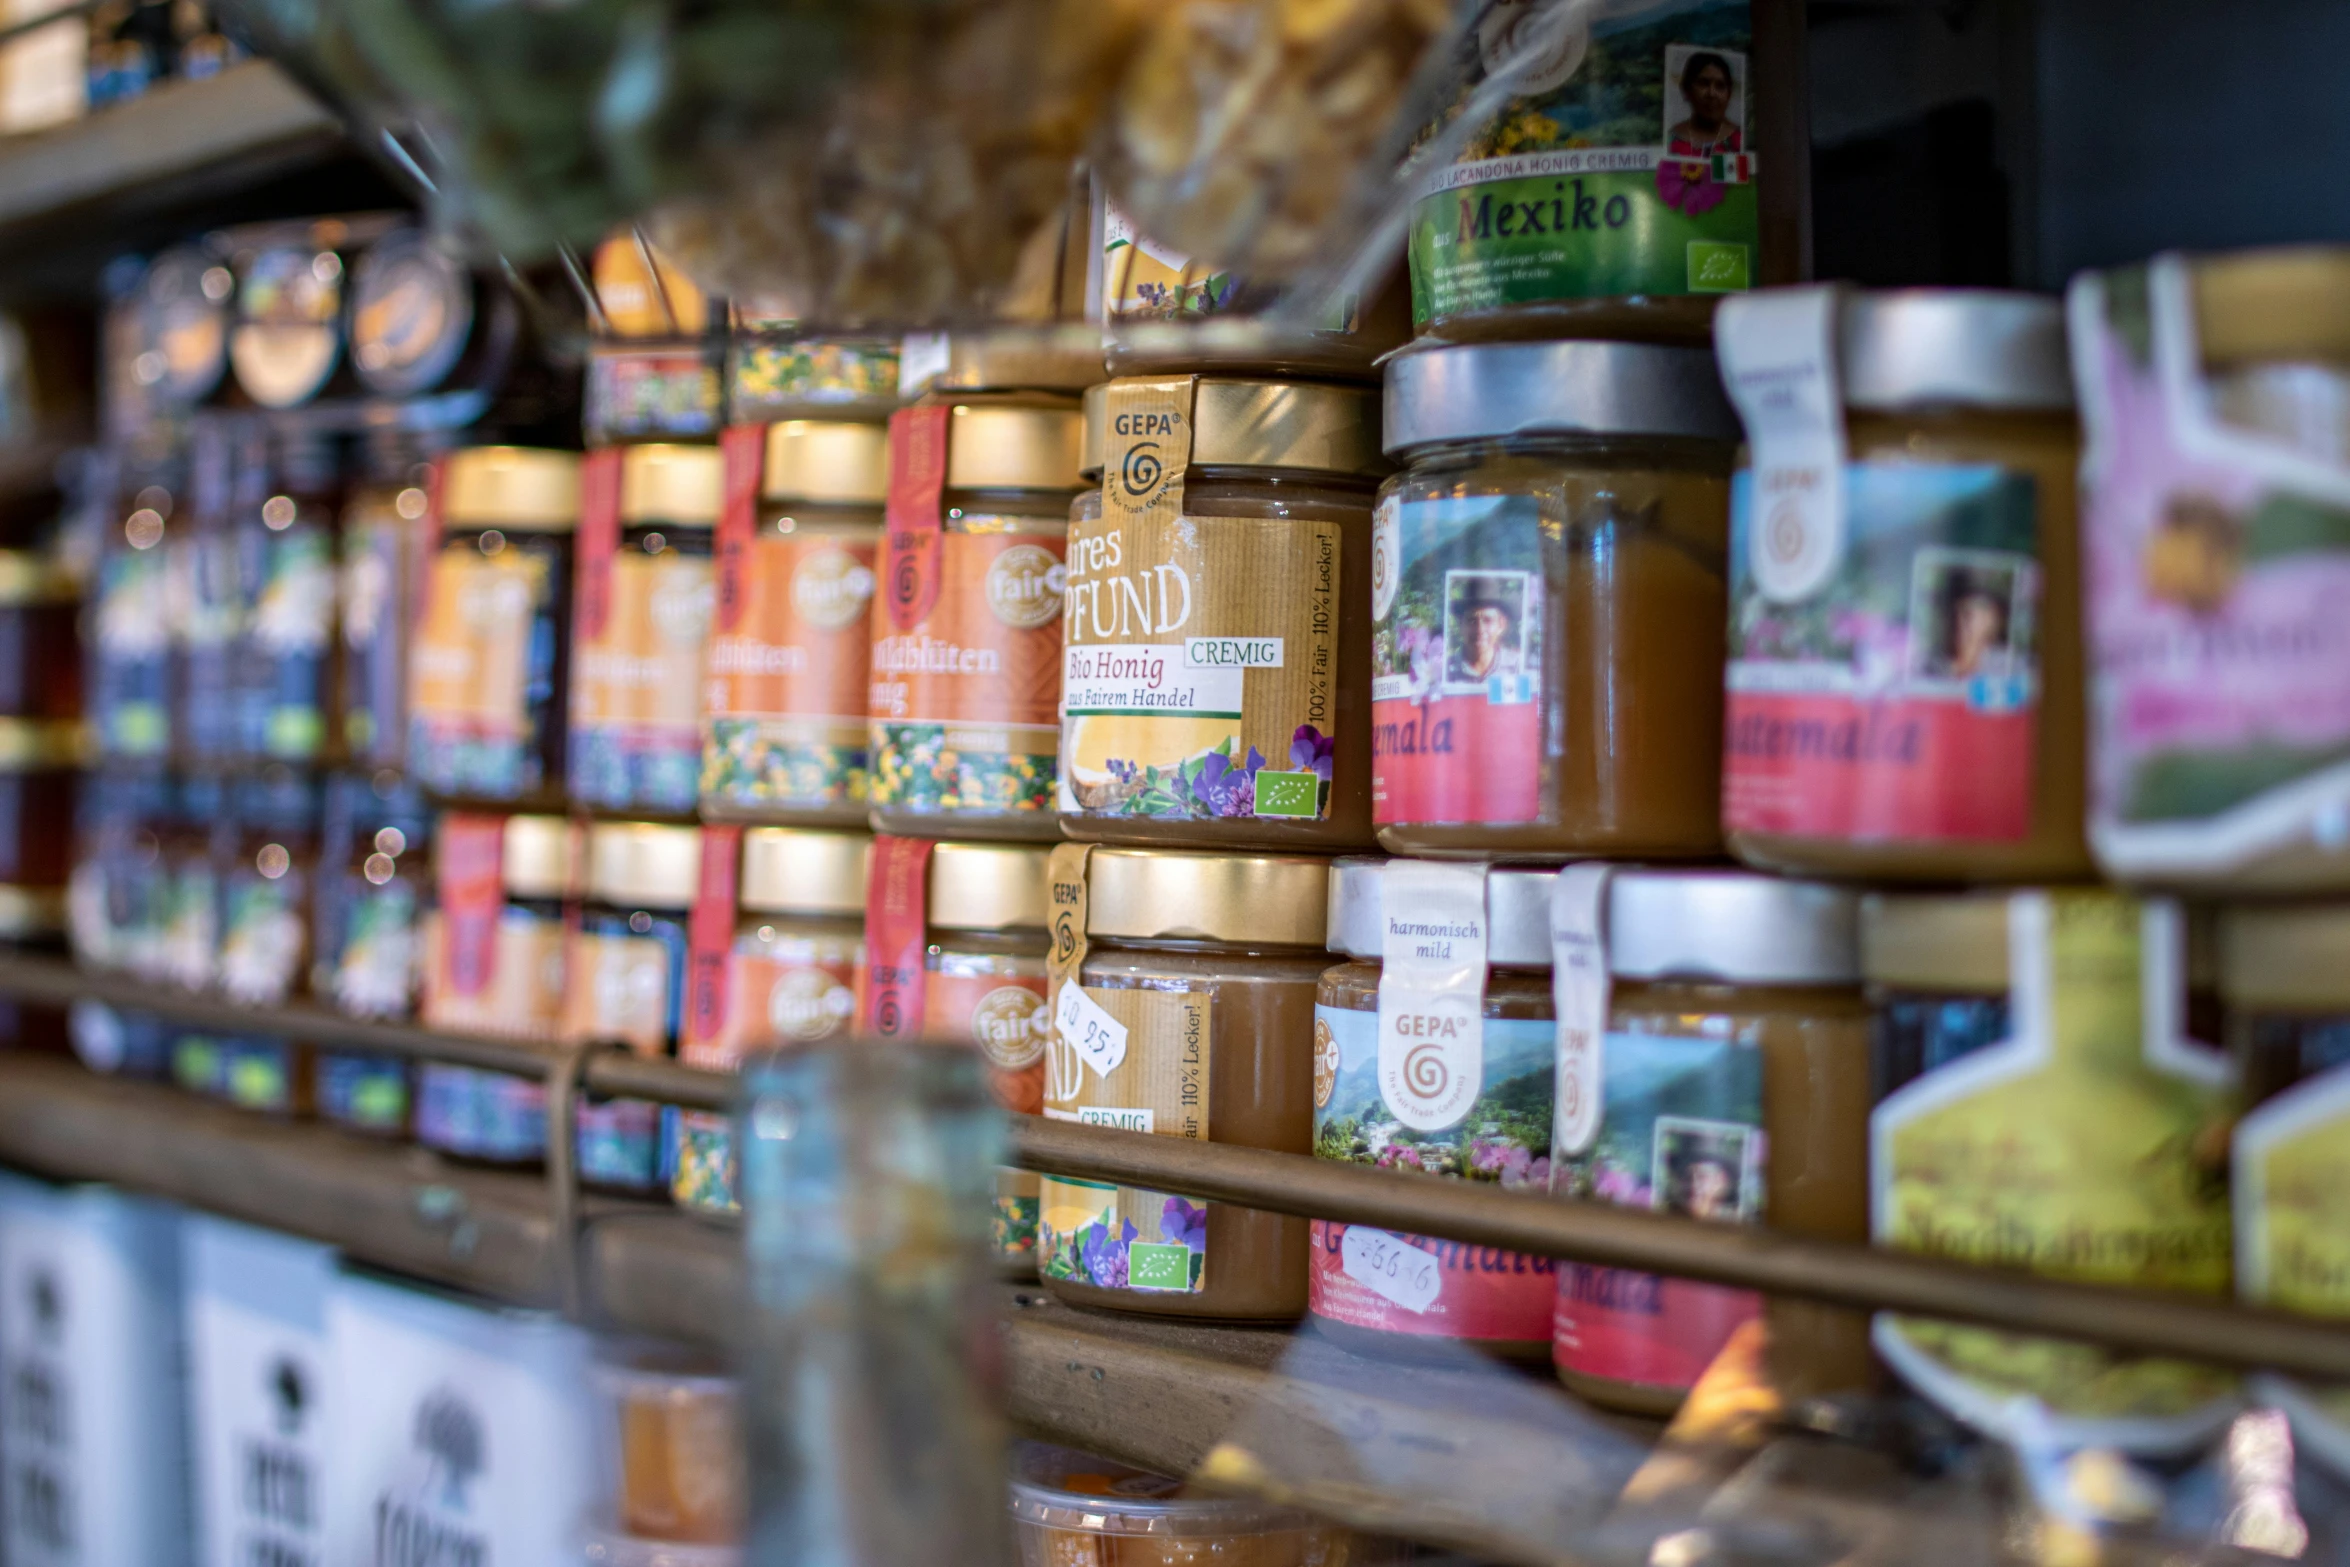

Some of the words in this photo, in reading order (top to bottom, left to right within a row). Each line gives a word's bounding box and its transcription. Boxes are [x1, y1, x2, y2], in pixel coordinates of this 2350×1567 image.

[1447, 160, 1523, 187] LACANDONA
[1530, 154, 1580, 173] HONIG
[1587, 152, 1650, 170] CREMIG
[1456, 178, 1630, 243] Mexiko
[1315, 533, 1332, 593] Lecker!
[1312, 596, 1331, 635] 110%
[1069, 650, 1092, 680] Bio
[1095, 649, 1165, 689] Honig
[1191, 641, 1276, 665] CREMIG
[1312, 644, 1328, 676] Fair
[1084, 687, 1128, 707] Fairem
[1132, 687, 1196, 707] Handel
[1309, 680, 1327, 722] 100%
[1389, 916, 1480, 939] harmonisch
[1416, 941, 1452, 960] mild
[1183, 1004, 1201, 1064] Lecker!
[1180, 1068, 1201, 1106] 110%
[1183, 1115, 1198, 1139] air
[1377, 1297, 1392, 1309] aus
